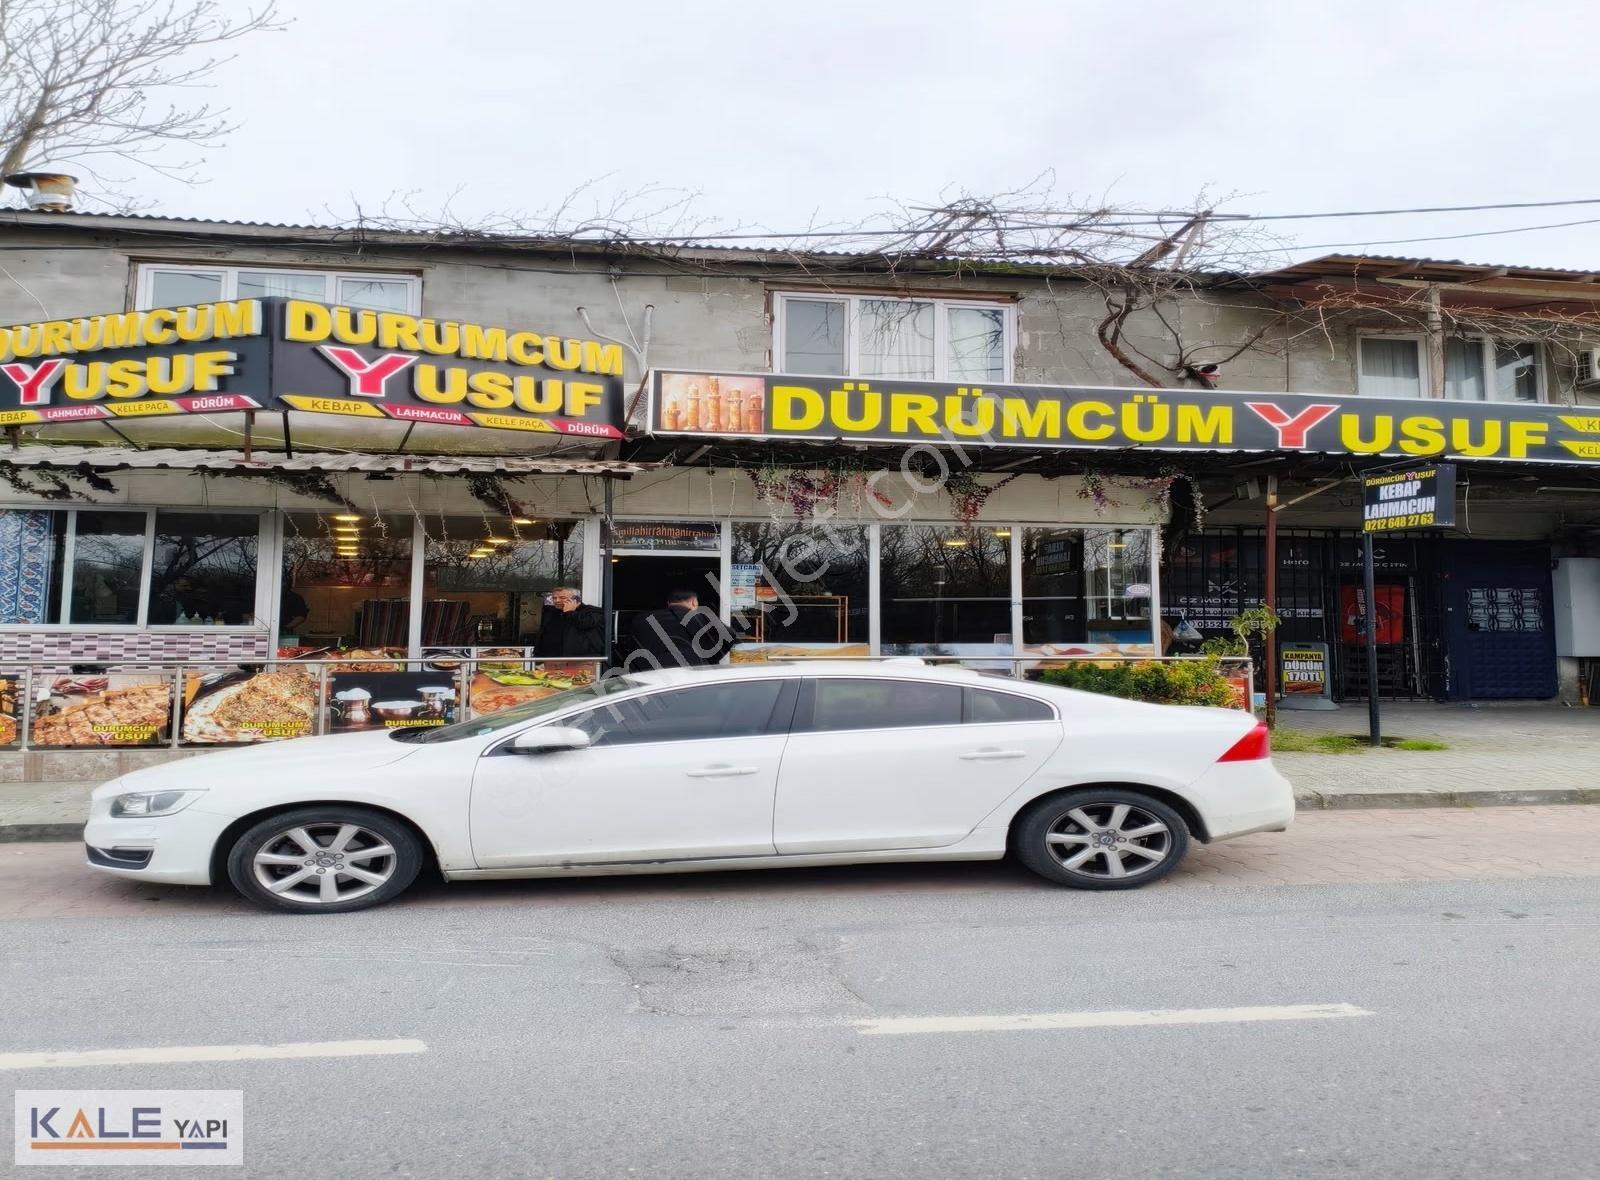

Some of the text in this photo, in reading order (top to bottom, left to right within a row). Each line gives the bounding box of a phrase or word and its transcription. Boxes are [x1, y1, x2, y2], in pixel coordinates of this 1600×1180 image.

[1, 351, 237, 405] YUSUF
[316, 345, 604, 416] YUSUF
[116, 402, 143, 414] KELLE
[192, 396, 234, 410] DÜRÜM
[311, 399, 362, 413] KEBAP
[47, 407, 97, 419] LAHMACUN
[396, 407, 462, 421] LAHMACUN
[772, 382, 1549, 458] DÜRÜMCÜM YUSUF
[486, 416, 545, 429] KELLE PAÇA
[568, 423, 609, 435] DÜRÜM
[1406, 469, 1437, 481] YUSUF
[1379, 480, 1421, 500] KEBAP
[1364, 496, 1436, 520] LAHMACUN
[1364, 512, 1434, 531] 0212 648 27 63
[1284, 652, 1322, 660] KAMPANYA
[1284, 660, 1323, 670] DÜRÜM
[1287, 671, 1322, 681] 170TL
